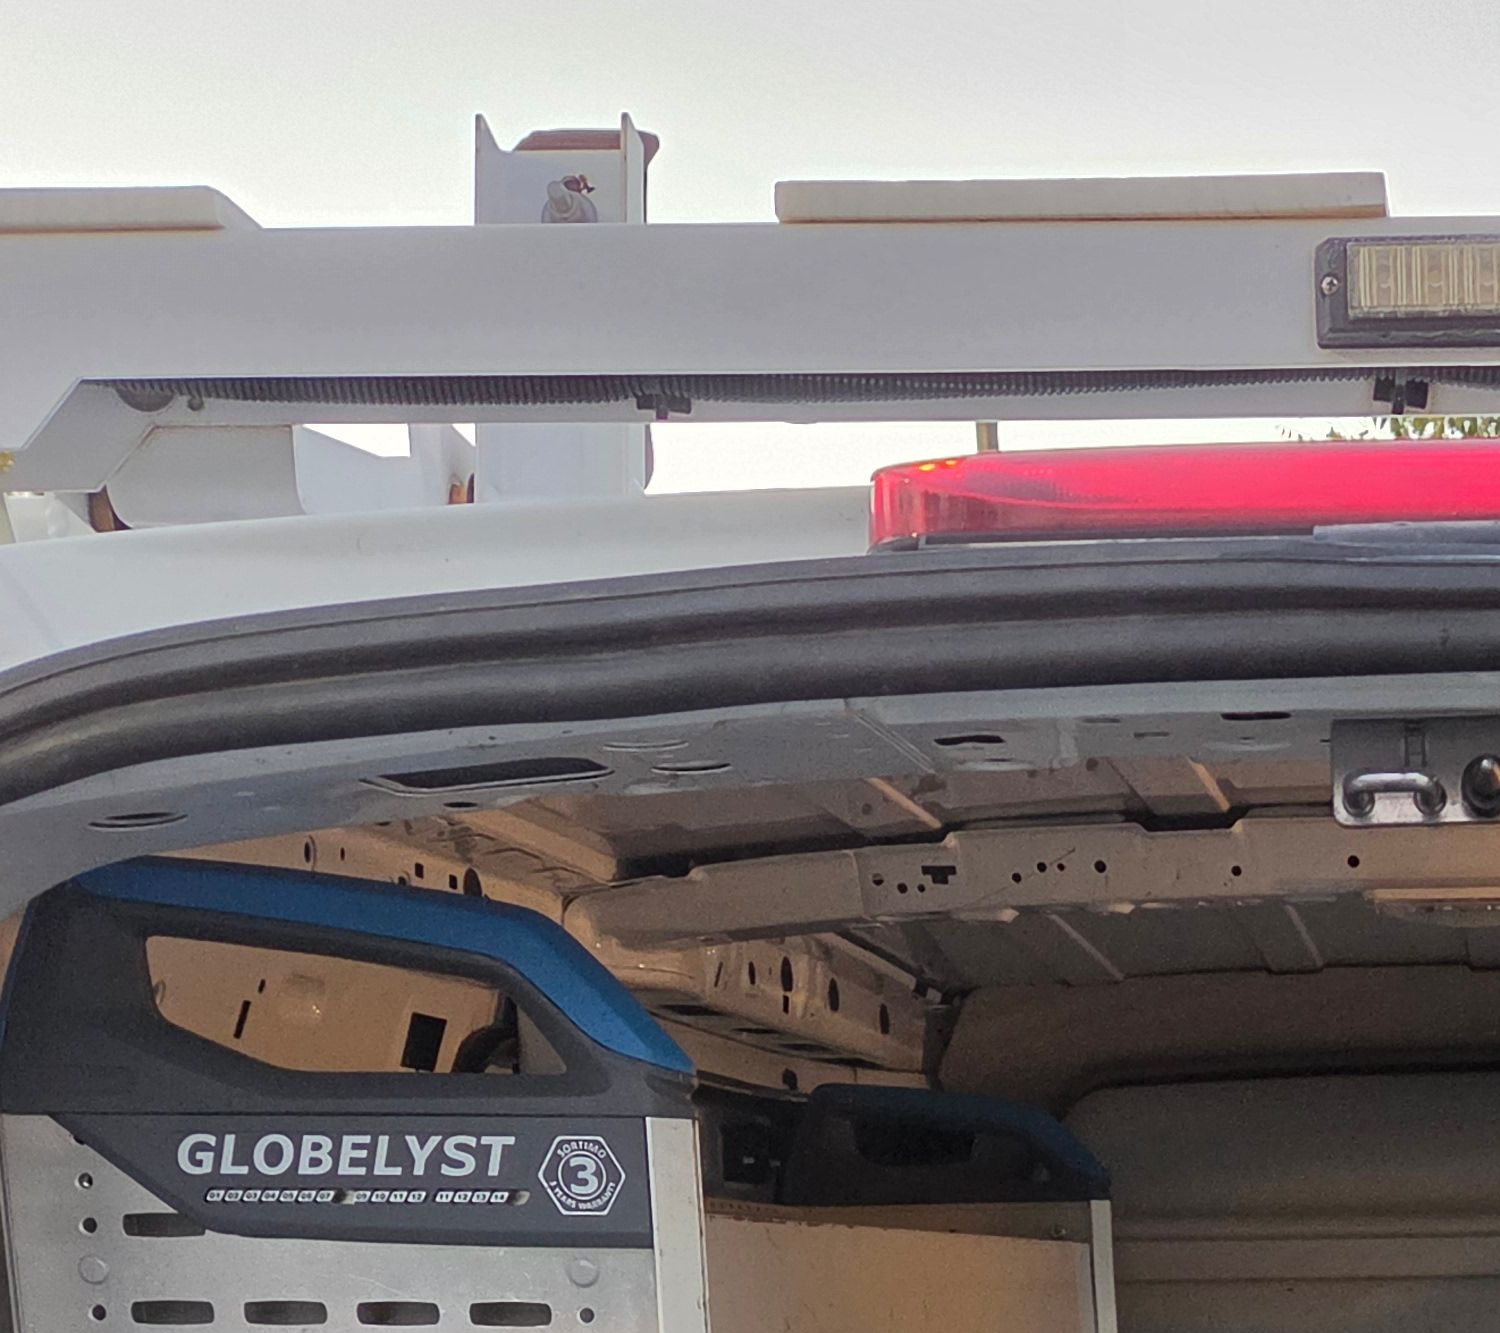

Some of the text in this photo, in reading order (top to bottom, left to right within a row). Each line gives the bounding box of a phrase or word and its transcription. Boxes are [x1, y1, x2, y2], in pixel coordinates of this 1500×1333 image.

[177, 1134, 515, 1177] GLOBELYST
[557, 1141, 607, 1158] SORTIMO
[569, 1156, 599, 1194] 3
